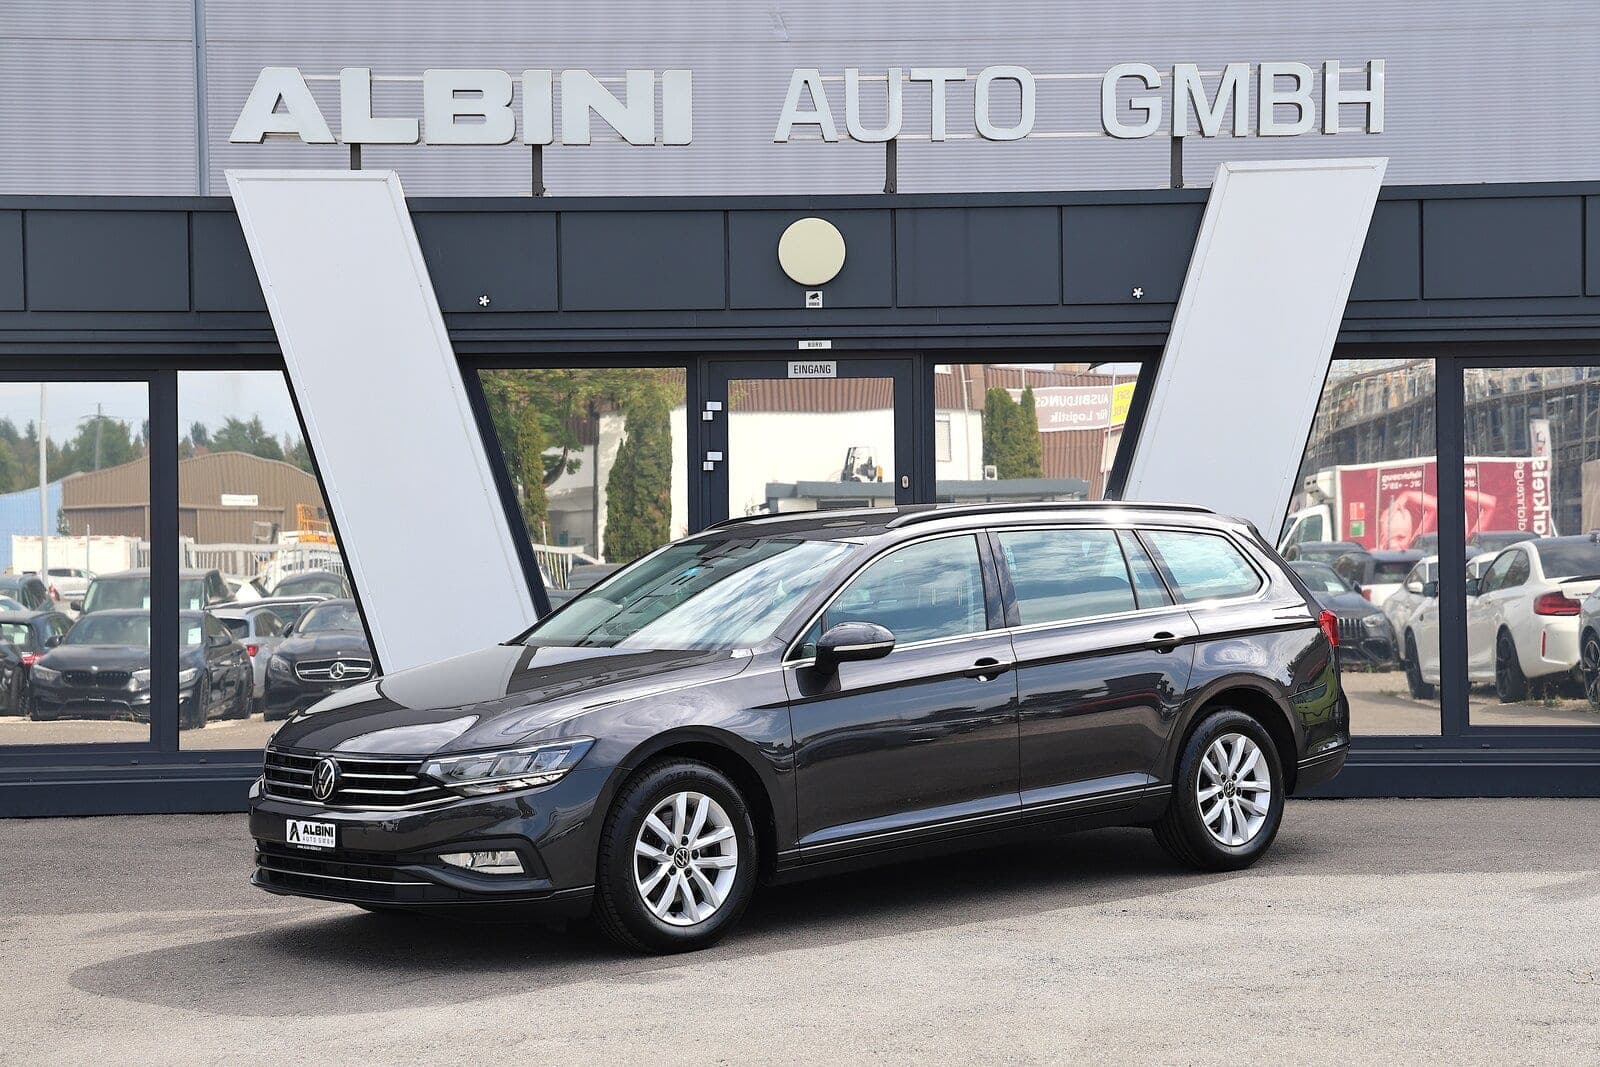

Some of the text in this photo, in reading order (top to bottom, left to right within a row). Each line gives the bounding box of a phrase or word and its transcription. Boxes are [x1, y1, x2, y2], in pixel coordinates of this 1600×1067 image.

[230, 58, 1386, 146] ALBINI AUTO GMBH
[793, 364, 832, 374] EINGANG
[303, 824, 334, 837] ALBINI
